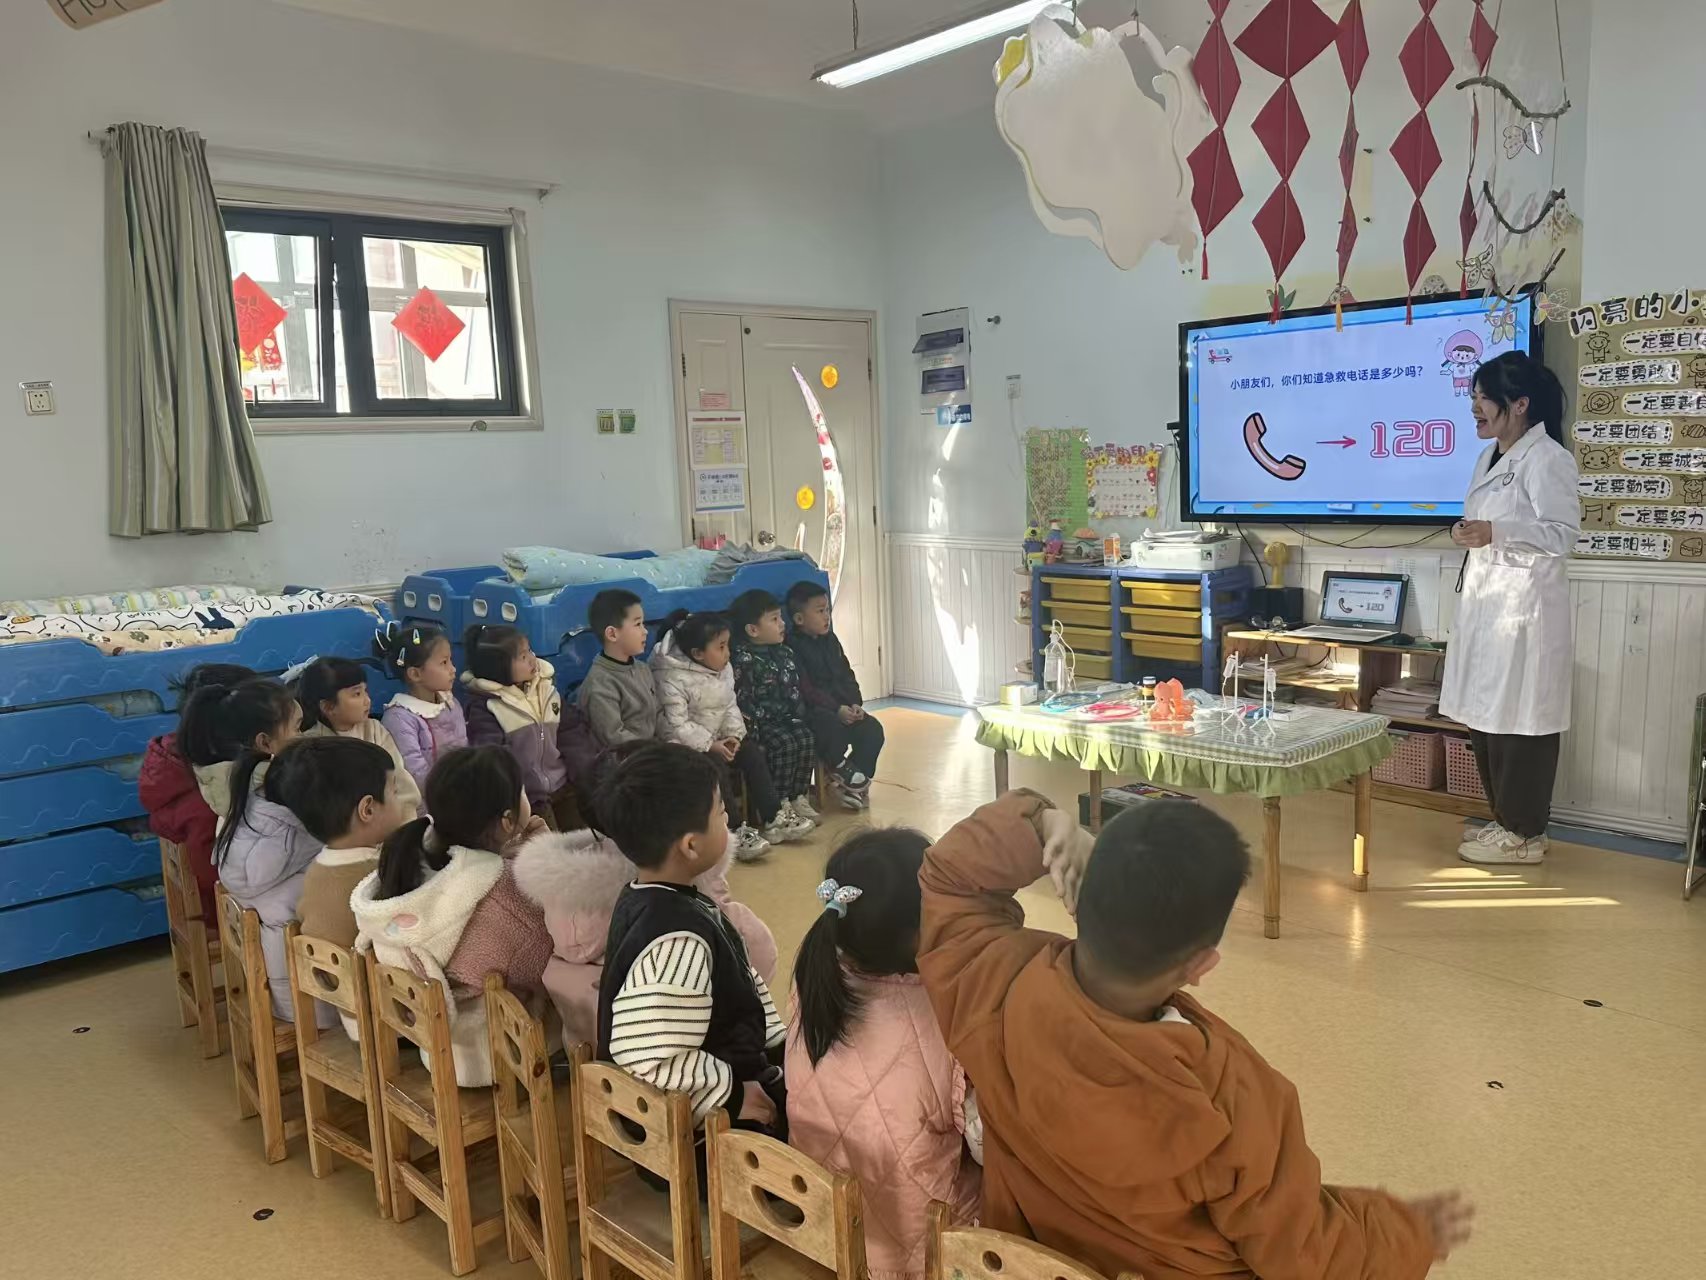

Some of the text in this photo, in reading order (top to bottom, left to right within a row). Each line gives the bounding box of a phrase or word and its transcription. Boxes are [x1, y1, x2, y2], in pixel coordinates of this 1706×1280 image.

[1230, 365, 1424, 391] 小朋友们，你们知道急救电话是多少吗？
[1370, 419, 1456, 458] 120
[1366, 602, 1385, 612] 120
